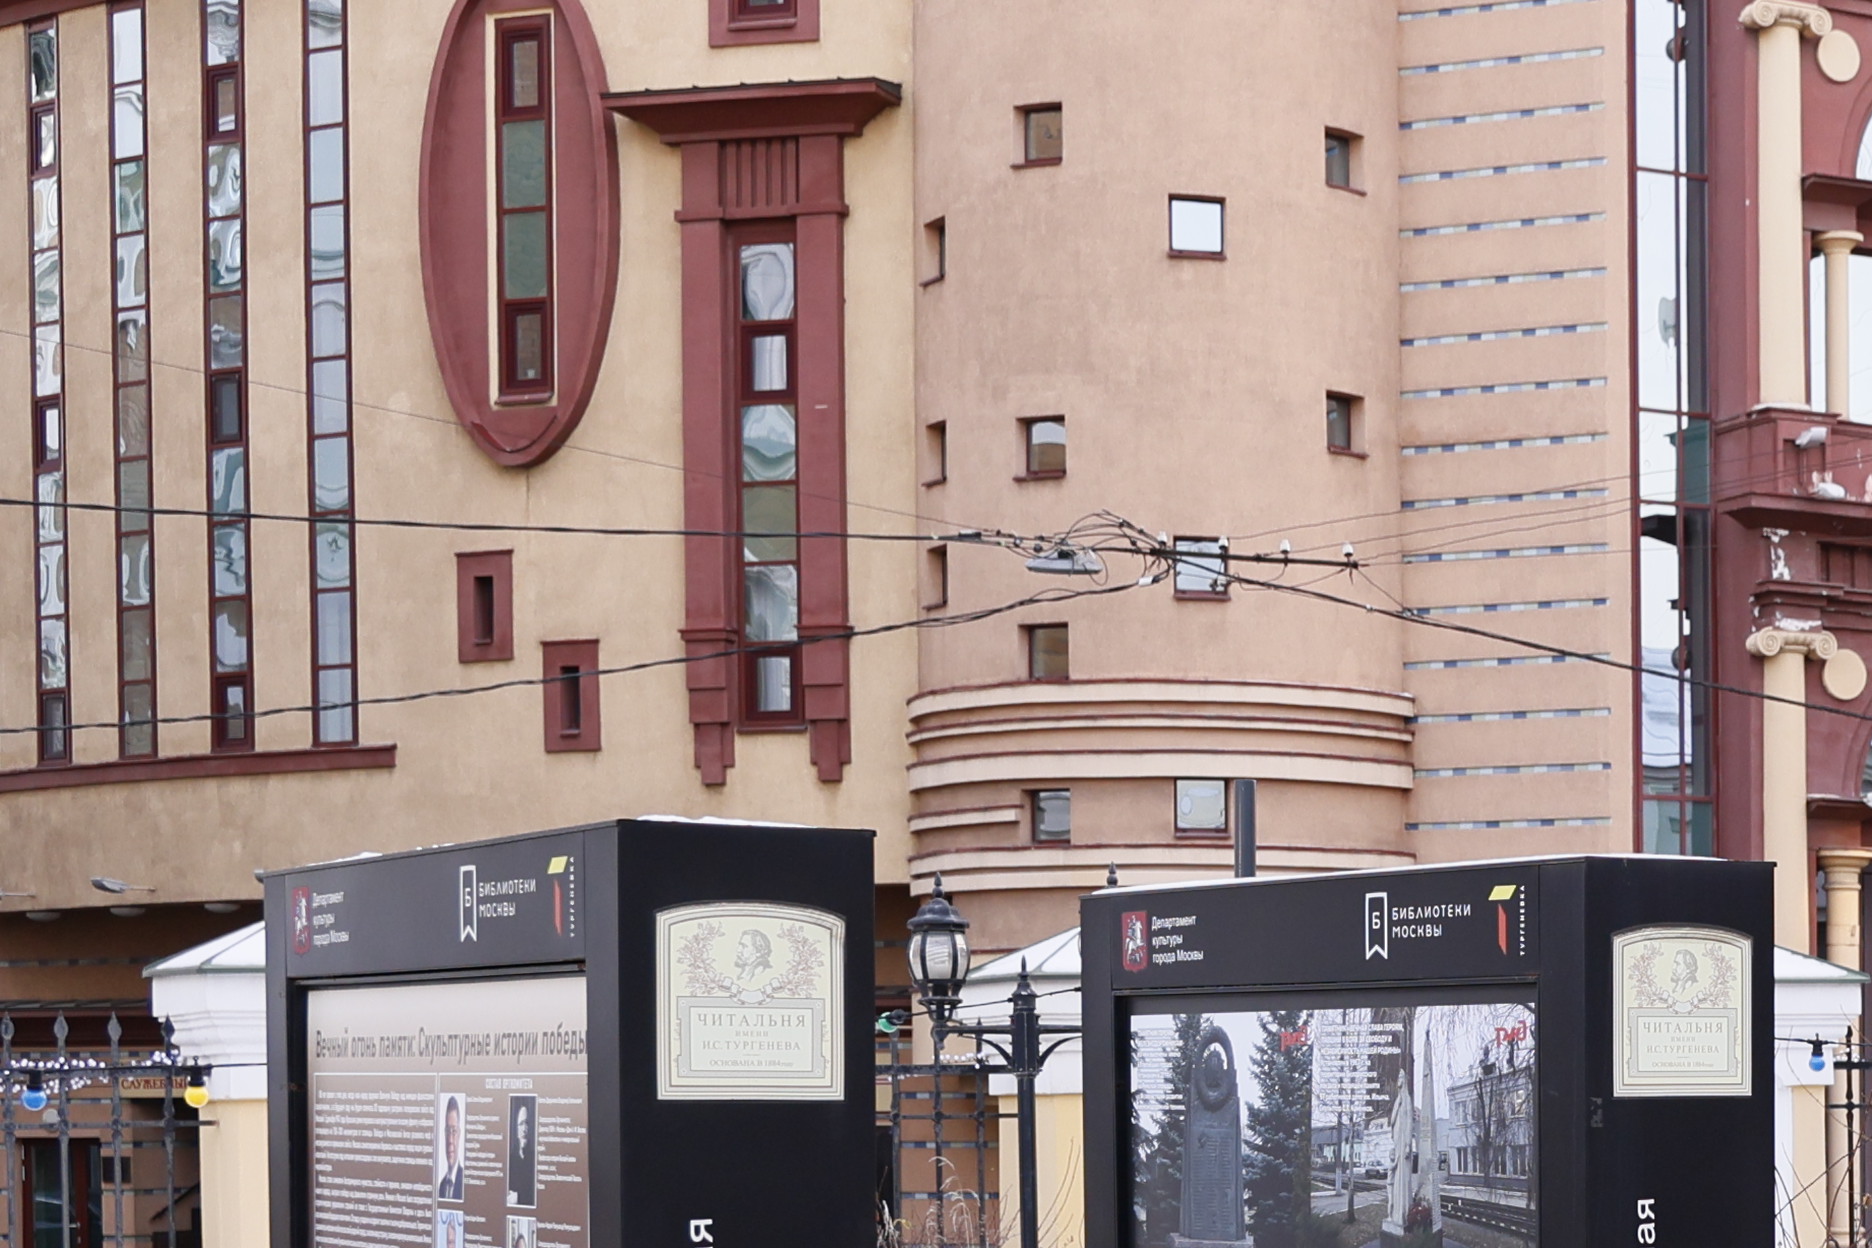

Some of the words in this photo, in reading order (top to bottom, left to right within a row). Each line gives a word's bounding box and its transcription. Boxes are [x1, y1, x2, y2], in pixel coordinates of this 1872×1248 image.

[478, 878, 537, 898] БИБЛИОТЕКИ
[478, 902, 516, 918] МОСКВЫ
[1391, 903, 1472, 921] БИБЛИОТЕКИ
[1151, 915, 1197, 931] Департамент
[1391, 924, 1443, 939] МОСКВЫ
[1151, 934, 1183, 949] культуры
[1152, 951, 1176, 966] города
[1176, 949, 1204, 962] Москвы
[697, 1012, 807, 1028] ЧИТАЛЬНЯ
[1643, 1022, 1724, 1034] ЧИТАЛЬНЯ
[735, 1030, 769, 1038] ИМЕНИ
[315, 1026, 350, 1059] Вечный
[352, 1037, 377, 1059] огонь
[379, 1036, 416, 1059] памяти:
[418, 1027, 493, 1064] Скульптурные
[494, 1030, 539, 1062] истории
[709, 1058, 757, 1067] ОСНОВАНА
